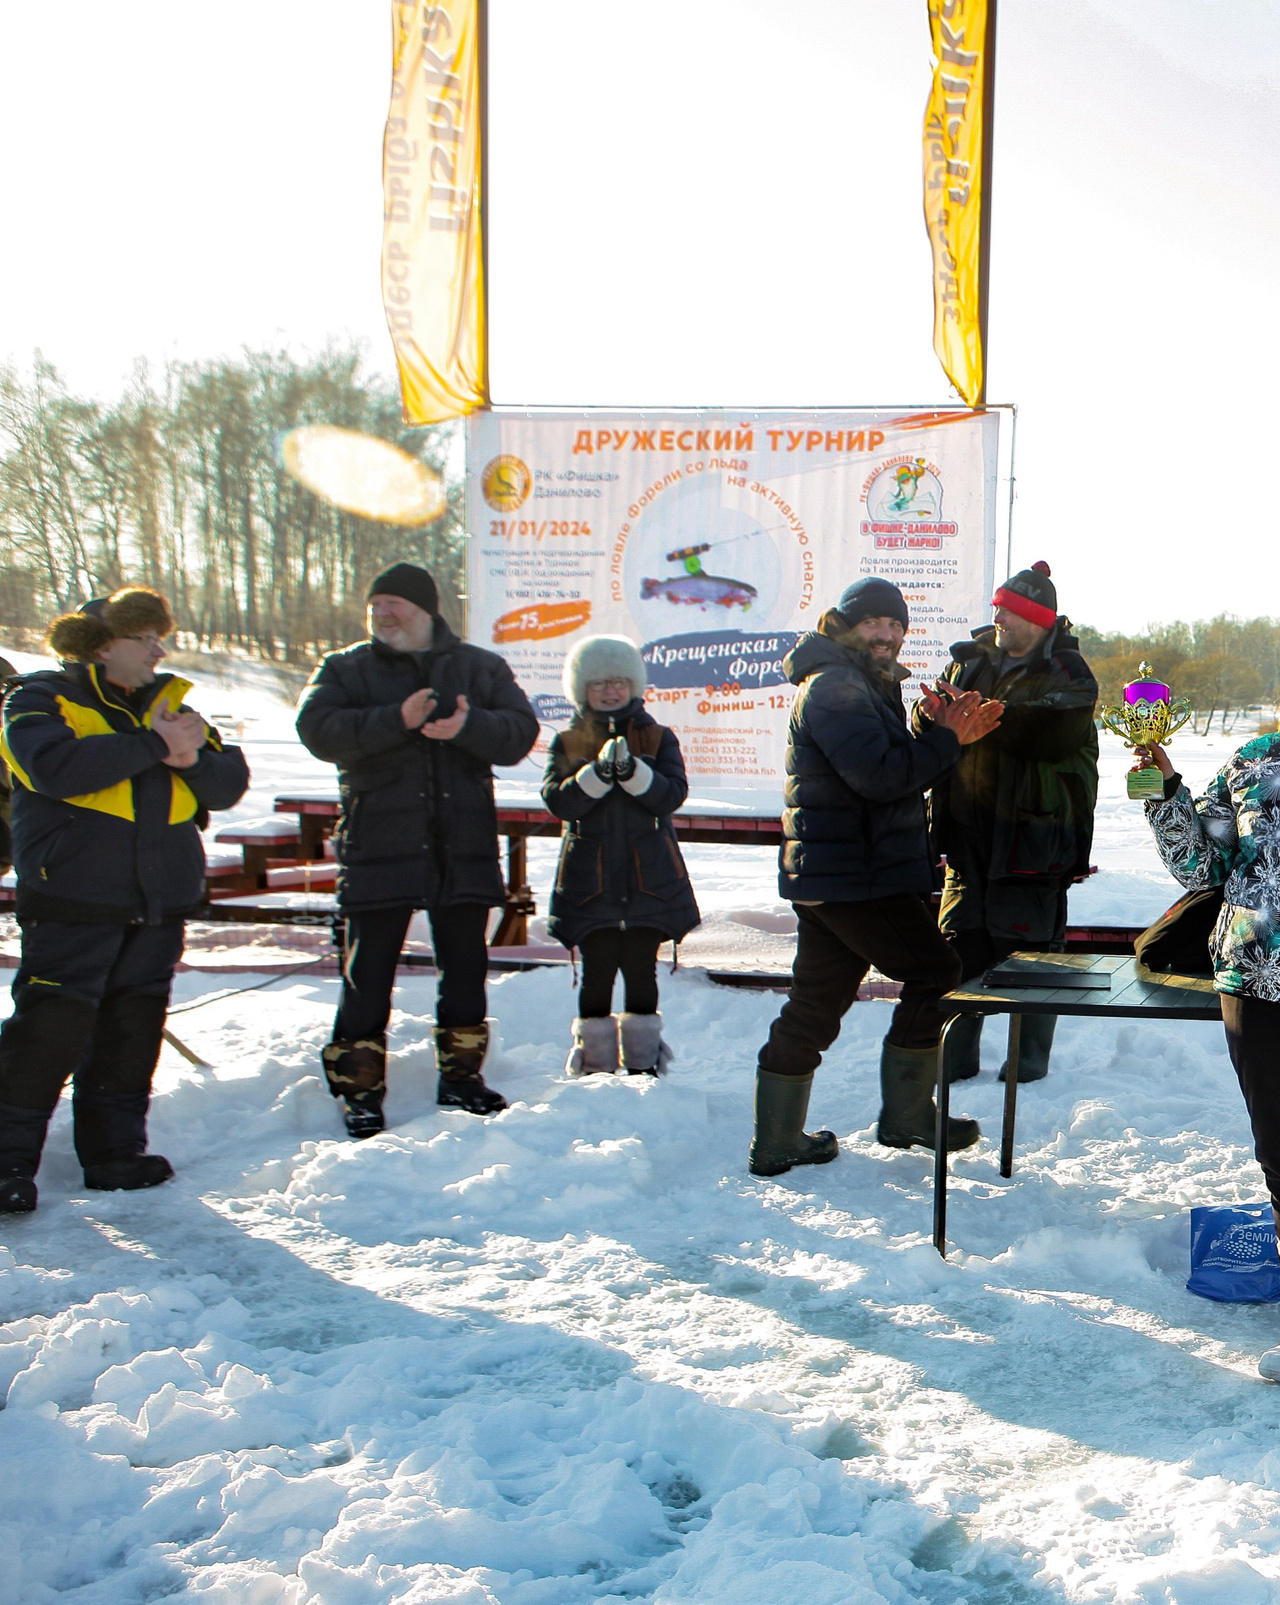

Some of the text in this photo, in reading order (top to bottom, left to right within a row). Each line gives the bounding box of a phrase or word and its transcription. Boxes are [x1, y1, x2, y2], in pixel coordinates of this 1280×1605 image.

[572, 423, 885, 455] ДРУЖЕСКИЙ ТУРНИР
[685, 460, 704, 475] со
[708, 457, 749, 472] льда
[534, 469, 619, 483] РК «Фишка»
[533, 485, 602, 499] Данилово
[490, 520, 592, 542] 21/01/2024
[610, 523, 632, 575] ловле
[726, 473, 815, 611] на активную снасть
[860, 557, 958, 567] Ловля производится
[879, 567, 924, 575] активную
[926, 566, 958, 575] снасть
[610, 582, 623, 602] по
[910, 605, 944, 614] медаль
[937, 615, 968, 624] фонда
[909, 639, 943, 647] медаль
[642, 637, 779, 668] «Крещенская
[910, 673, 941, 681] медал
[644, 687, 689, 704] Старт
[705, 682, 741, 698] 9:00
[697, 700, 755, 715] Финиш
[768, 695, 795, 709] 12:
[683, 724, 754, 735] Домодедовский
[702, 736, 746, 745] Данилово
